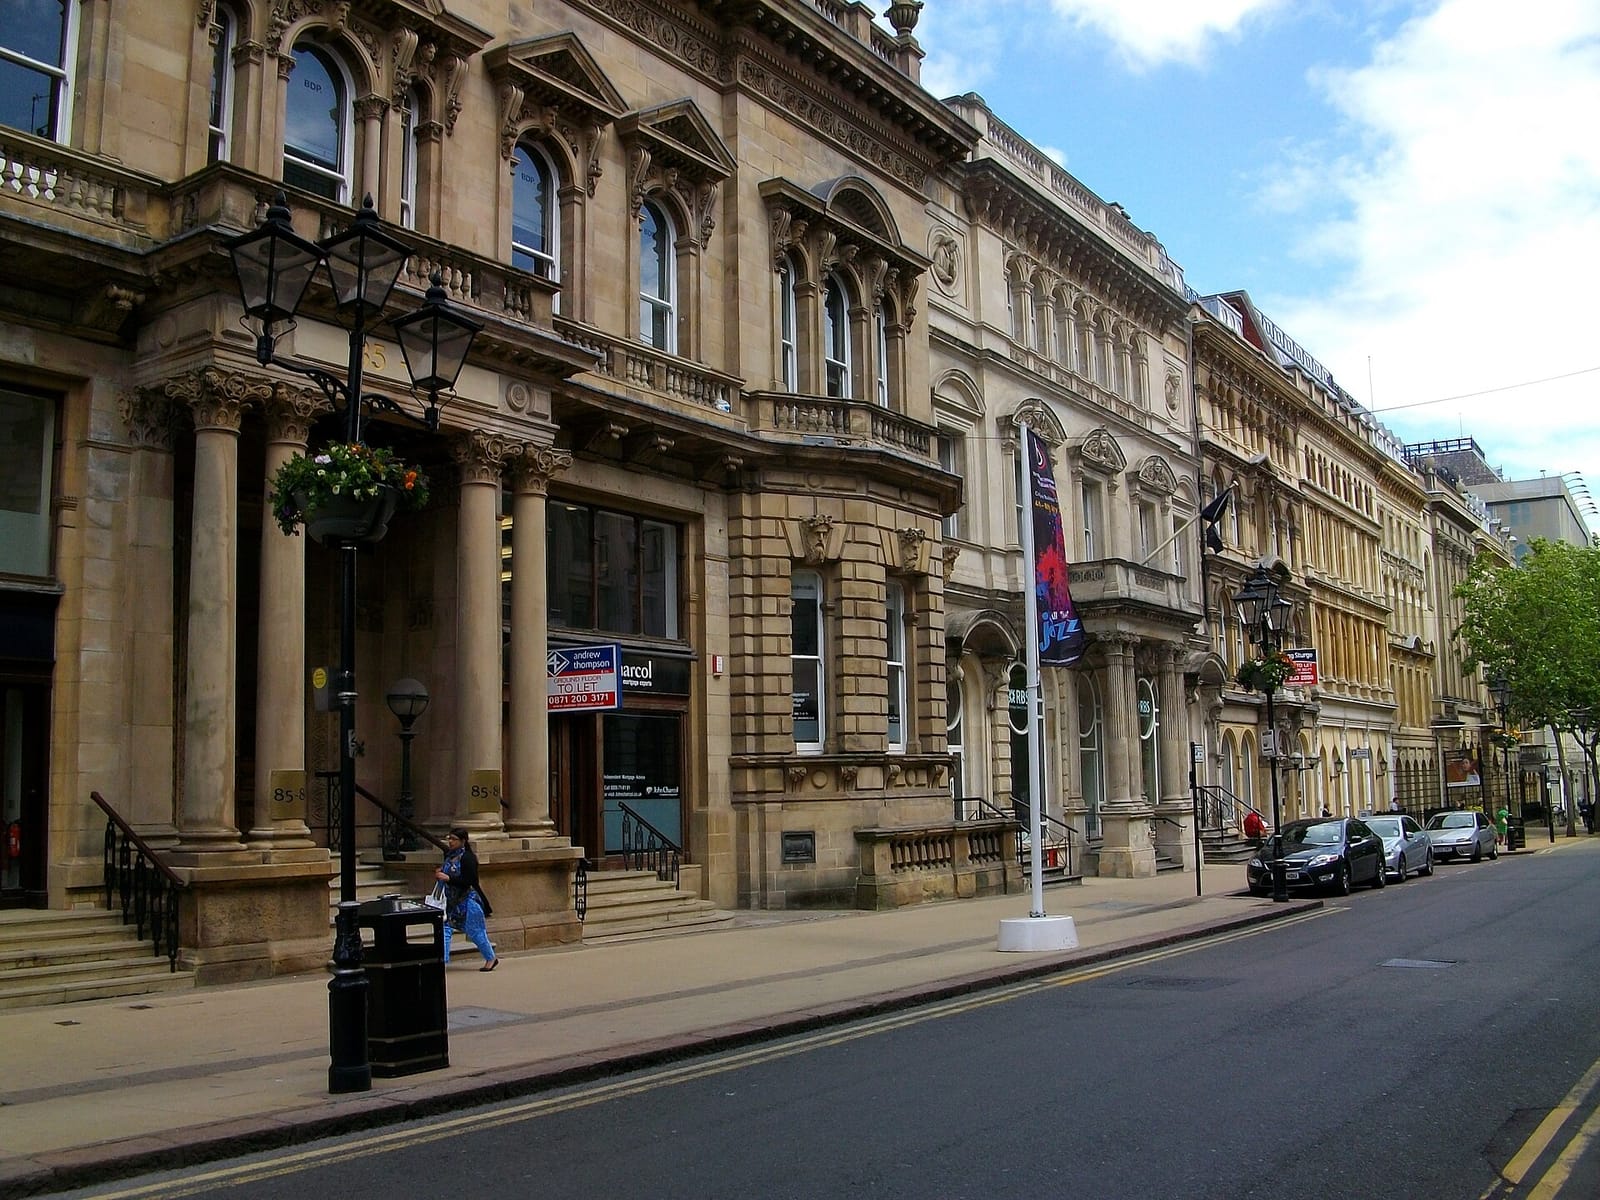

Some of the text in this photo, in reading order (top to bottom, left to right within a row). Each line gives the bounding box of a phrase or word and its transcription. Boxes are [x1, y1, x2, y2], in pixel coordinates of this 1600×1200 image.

[1039, 611, 1080, 652] jazz
[573, 651, 601, 660] andrew
[573, 660, 610, 670] thompson
[557, 682, 598, 694] TO LET
[549, 693, 609, 704] 0871 200 3171
